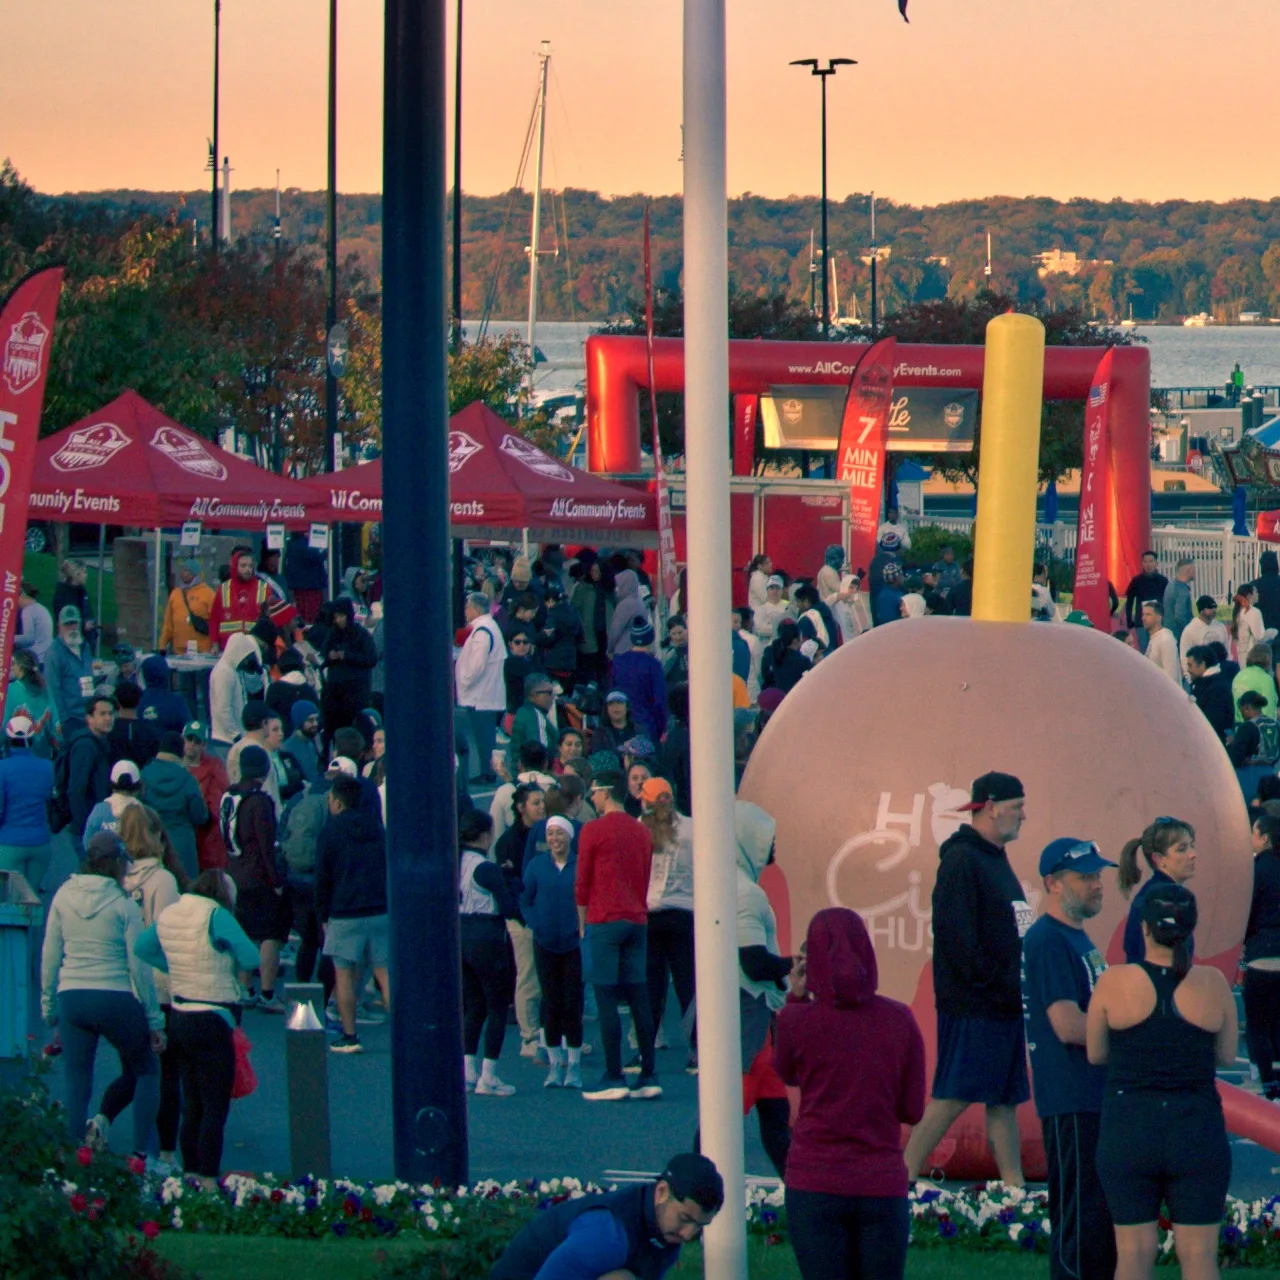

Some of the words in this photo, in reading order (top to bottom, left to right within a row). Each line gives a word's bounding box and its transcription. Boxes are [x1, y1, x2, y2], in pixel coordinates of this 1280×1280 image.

[858, 416, 878, 445] 7
[843, 447, 879, 467] MIN
[841, 471, 878, 489] MILE
[73, 488, 121, 512] Events
[190, 497, 208, 513] All
[208, 498, 269, 522] Community
[270, 498, 305, 518] Events
[449, 499, 485, 516] vents
[550, 498, 565, 517] All
[565, 498, 617, 523] Community
[617, 499, 647, 519] Events
